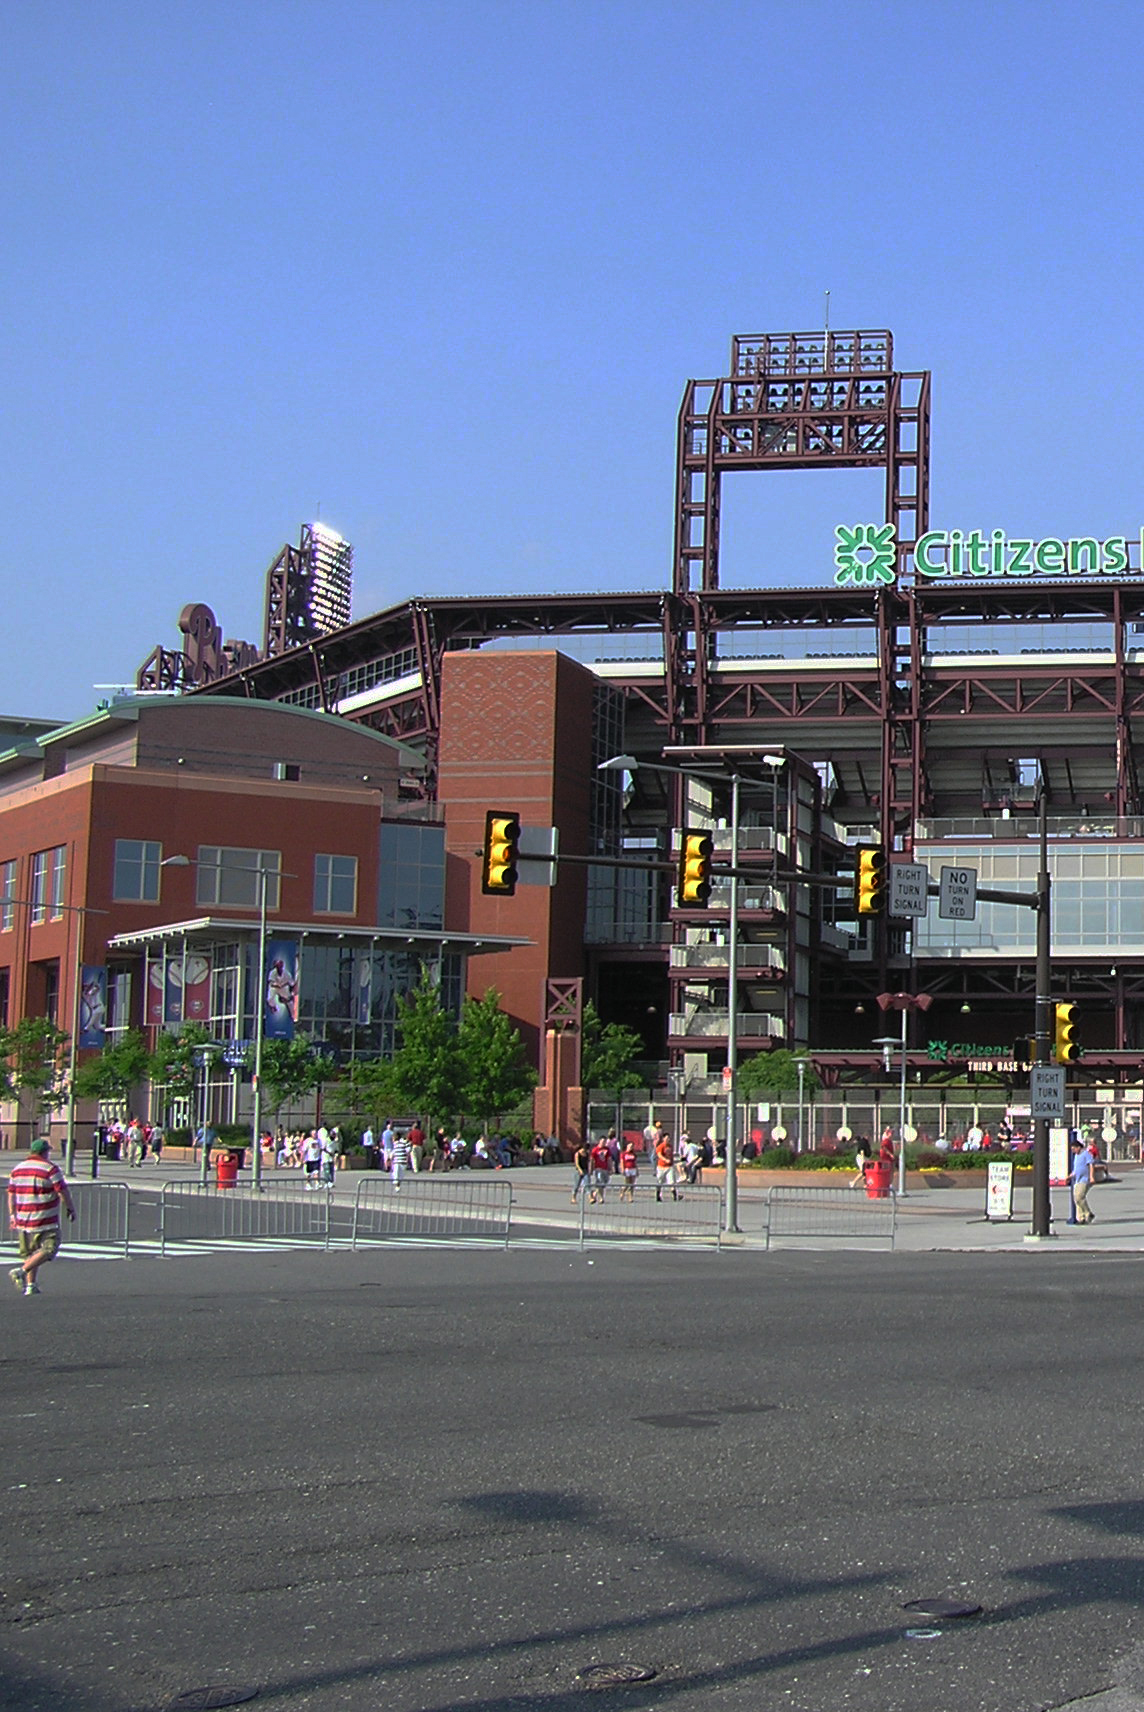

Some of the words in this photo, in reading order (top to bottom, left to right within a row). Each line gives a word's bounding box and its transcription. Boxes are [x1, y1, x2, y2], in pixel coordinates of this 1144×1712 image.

[914, 528, 1128, 576] Citizens
[896, 869, 921, 881] RIGHT
[949, 872, 968, 885] NO
[898, 884, 920, 895] TURN
[948, 885, 970, 895] TURN
[894, 899, 923, 911] SIGNAL
[952, 896, 964, 906] ON
[949, 907, 966, 917] RED
[951, 1043, 1010, 1057] Citizens
[967, 1061, 993, 1072] THIRD
[997, 1061, 1018, 1072] BASE
[1036, 1073, 1059, 1083] RIGHT
[1038, 1087, 1058, 1097] TURN
[1035, 1102, 1061, 1112] SIGNAL
[992, 1165, 1010, 1173] TEAM
